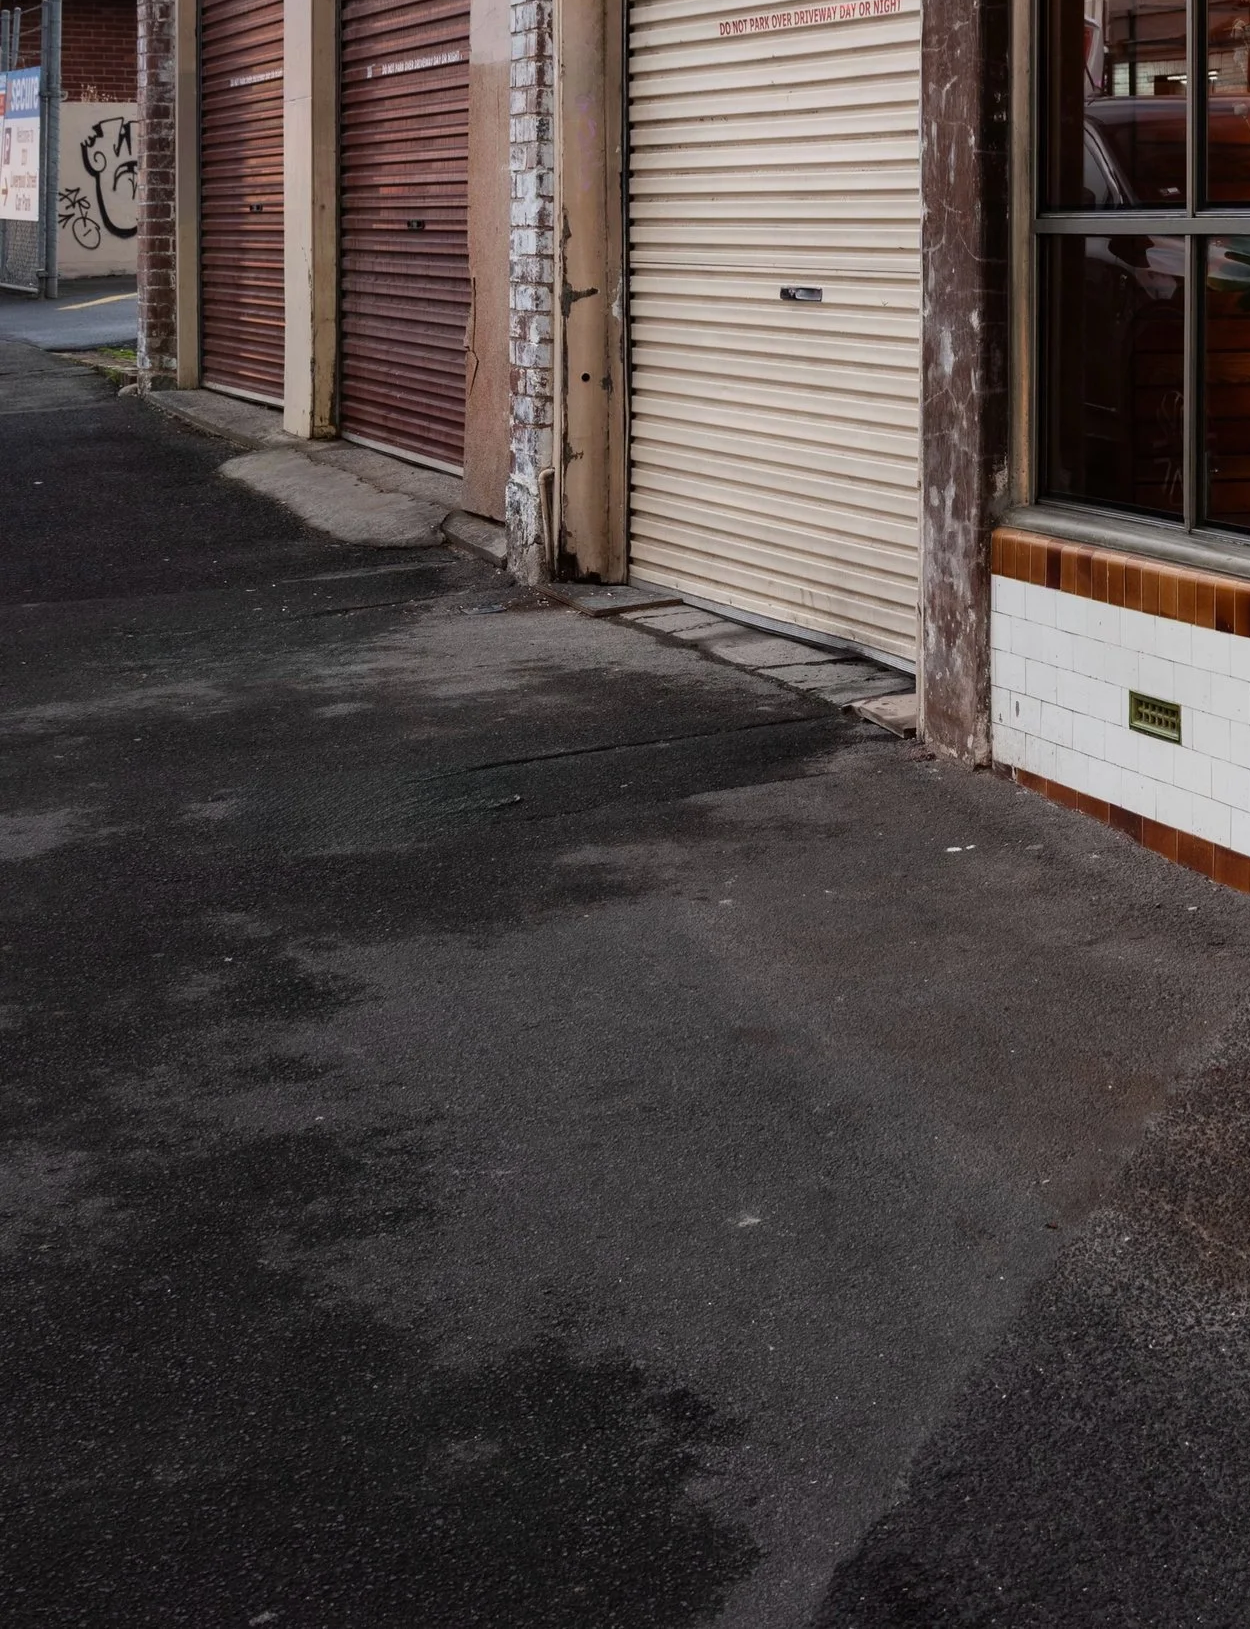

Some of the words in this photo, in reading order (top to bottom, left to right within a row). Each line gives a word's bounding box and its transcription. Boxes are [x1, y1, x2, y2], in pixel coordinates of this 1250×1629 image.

[719, 22, 732, 36] DO
[732, 19, 748, 34] NOT
[749, 16, 770, 32] PARK
[771, 12, 793, 29] OVER
[794, 5, 838, 26] DRIVEWAY
[839, 2, 857, 18] DAY
[858, 1, 871, 17] OR
[11, 75, 39, 111] secure
